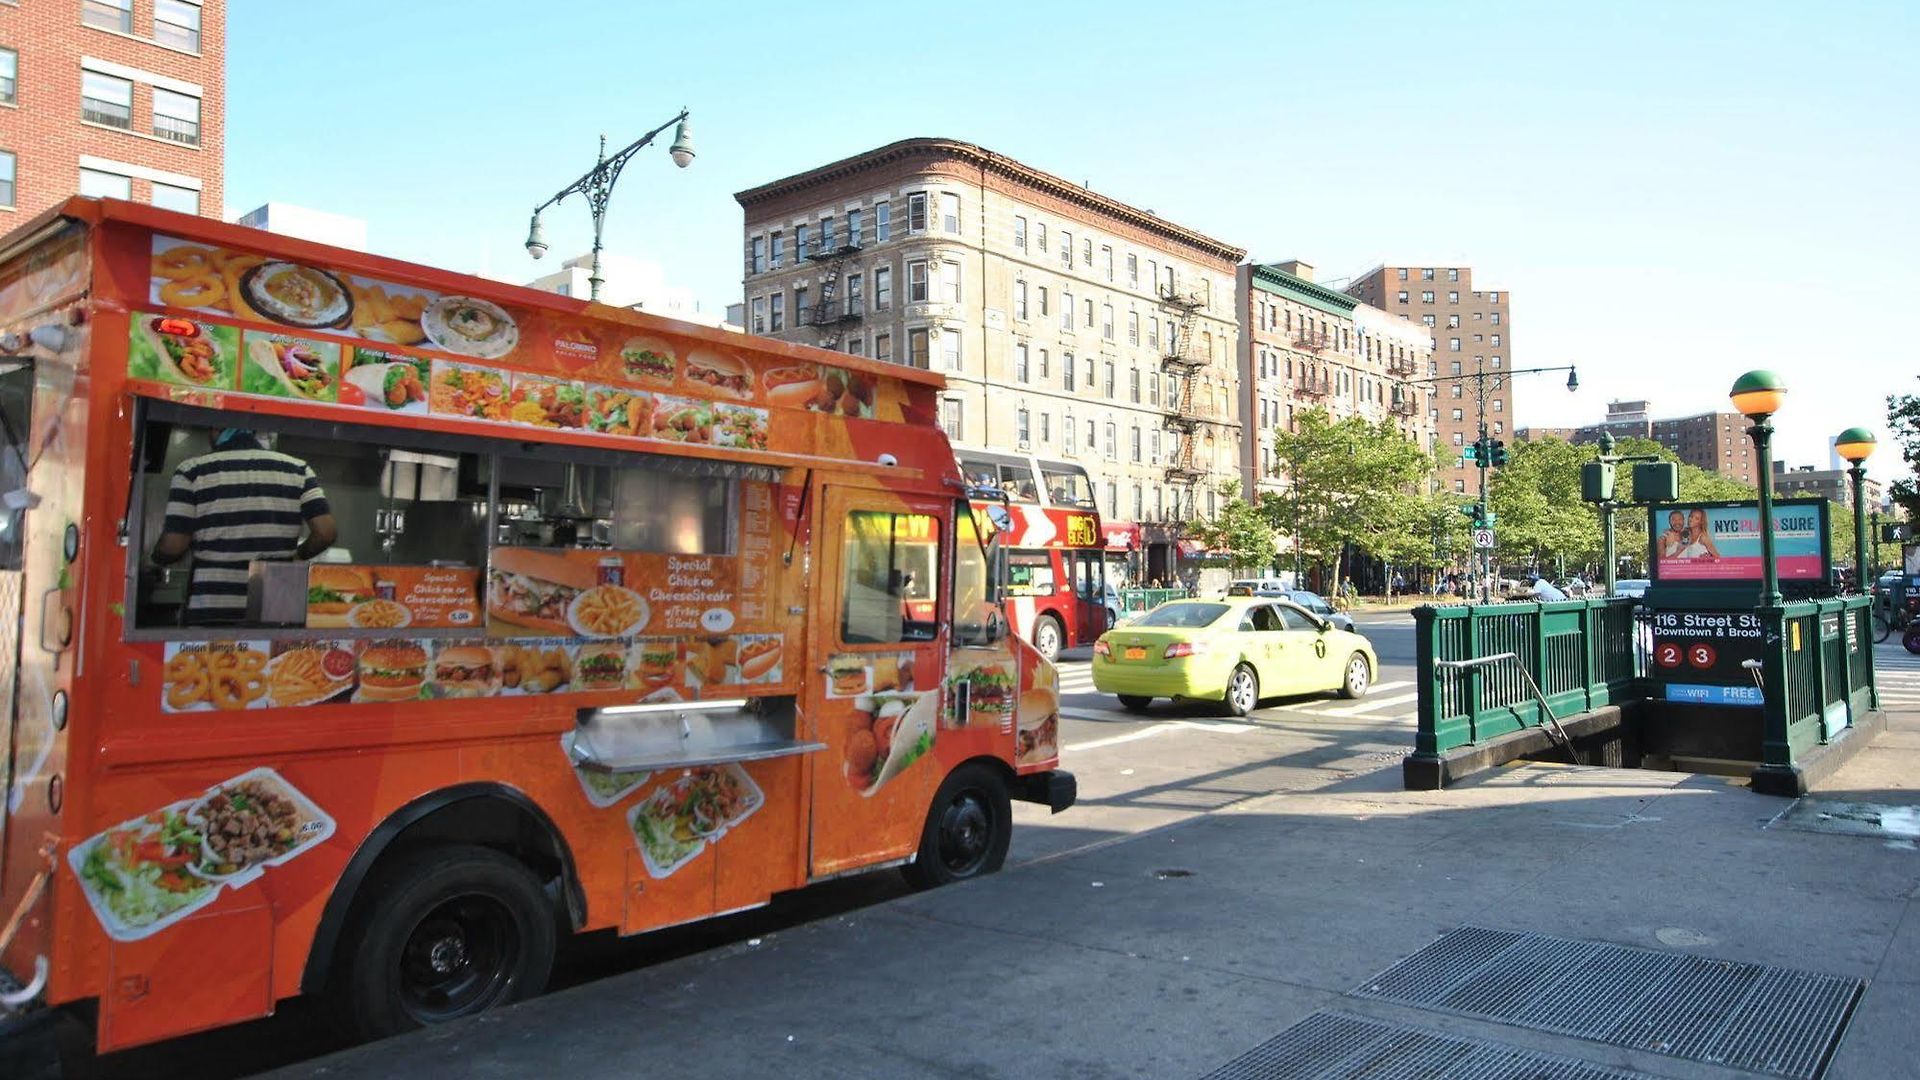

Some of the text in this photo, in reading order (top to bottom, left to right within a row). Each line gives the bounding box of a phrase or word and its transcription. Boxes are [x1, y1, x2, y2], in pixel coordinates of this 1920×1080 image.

[1715, 519, 1739, 533] NYC
[1781, 517, 1815, 531] SURE
[668, 556, 711, 573] Special
[668, 574, 715, 587] Chicken
[1654, 614, 1677, 627] 116
[1684, 614, 1732, 628] Street
[1654, 626, 1712, 637] Downtown
[1716, 627, 1724, 637] &
[179, 643, 206, 653] Onion
[209, 643, 235, 654] Rings
[1664, 648, 1676, 662] 2
[1696, 648, 1708, 663] 3
[1723, 687, 1756, 699] FREE
